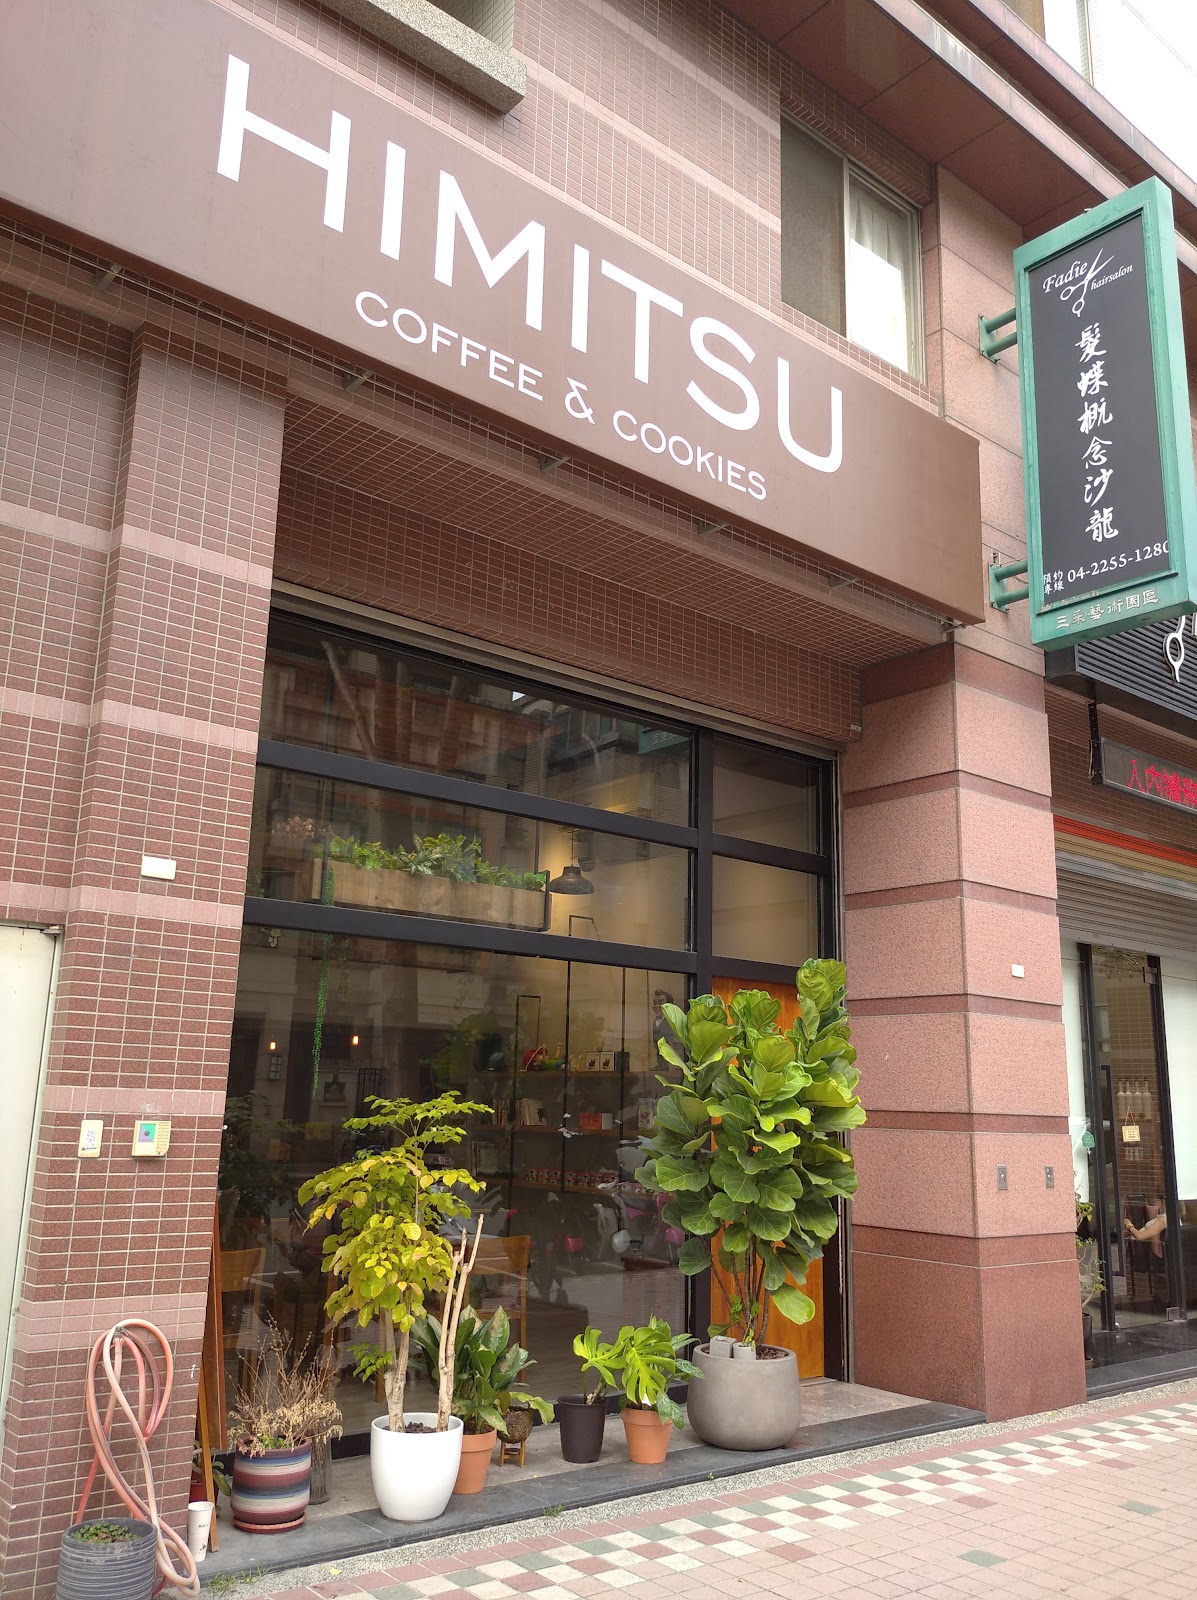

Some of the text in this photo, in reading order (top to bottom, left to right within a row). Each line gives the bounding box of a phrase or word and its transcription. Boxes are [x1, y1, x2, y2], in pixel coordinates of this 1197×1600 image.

[217, 54, 843, 473] HIMITSU
[1042, 261, 1088, 294] Fadie
[1090, 264, 1134, 291] hairsalon
[355, 291, 767, 500] COFFEE & COOKIES
